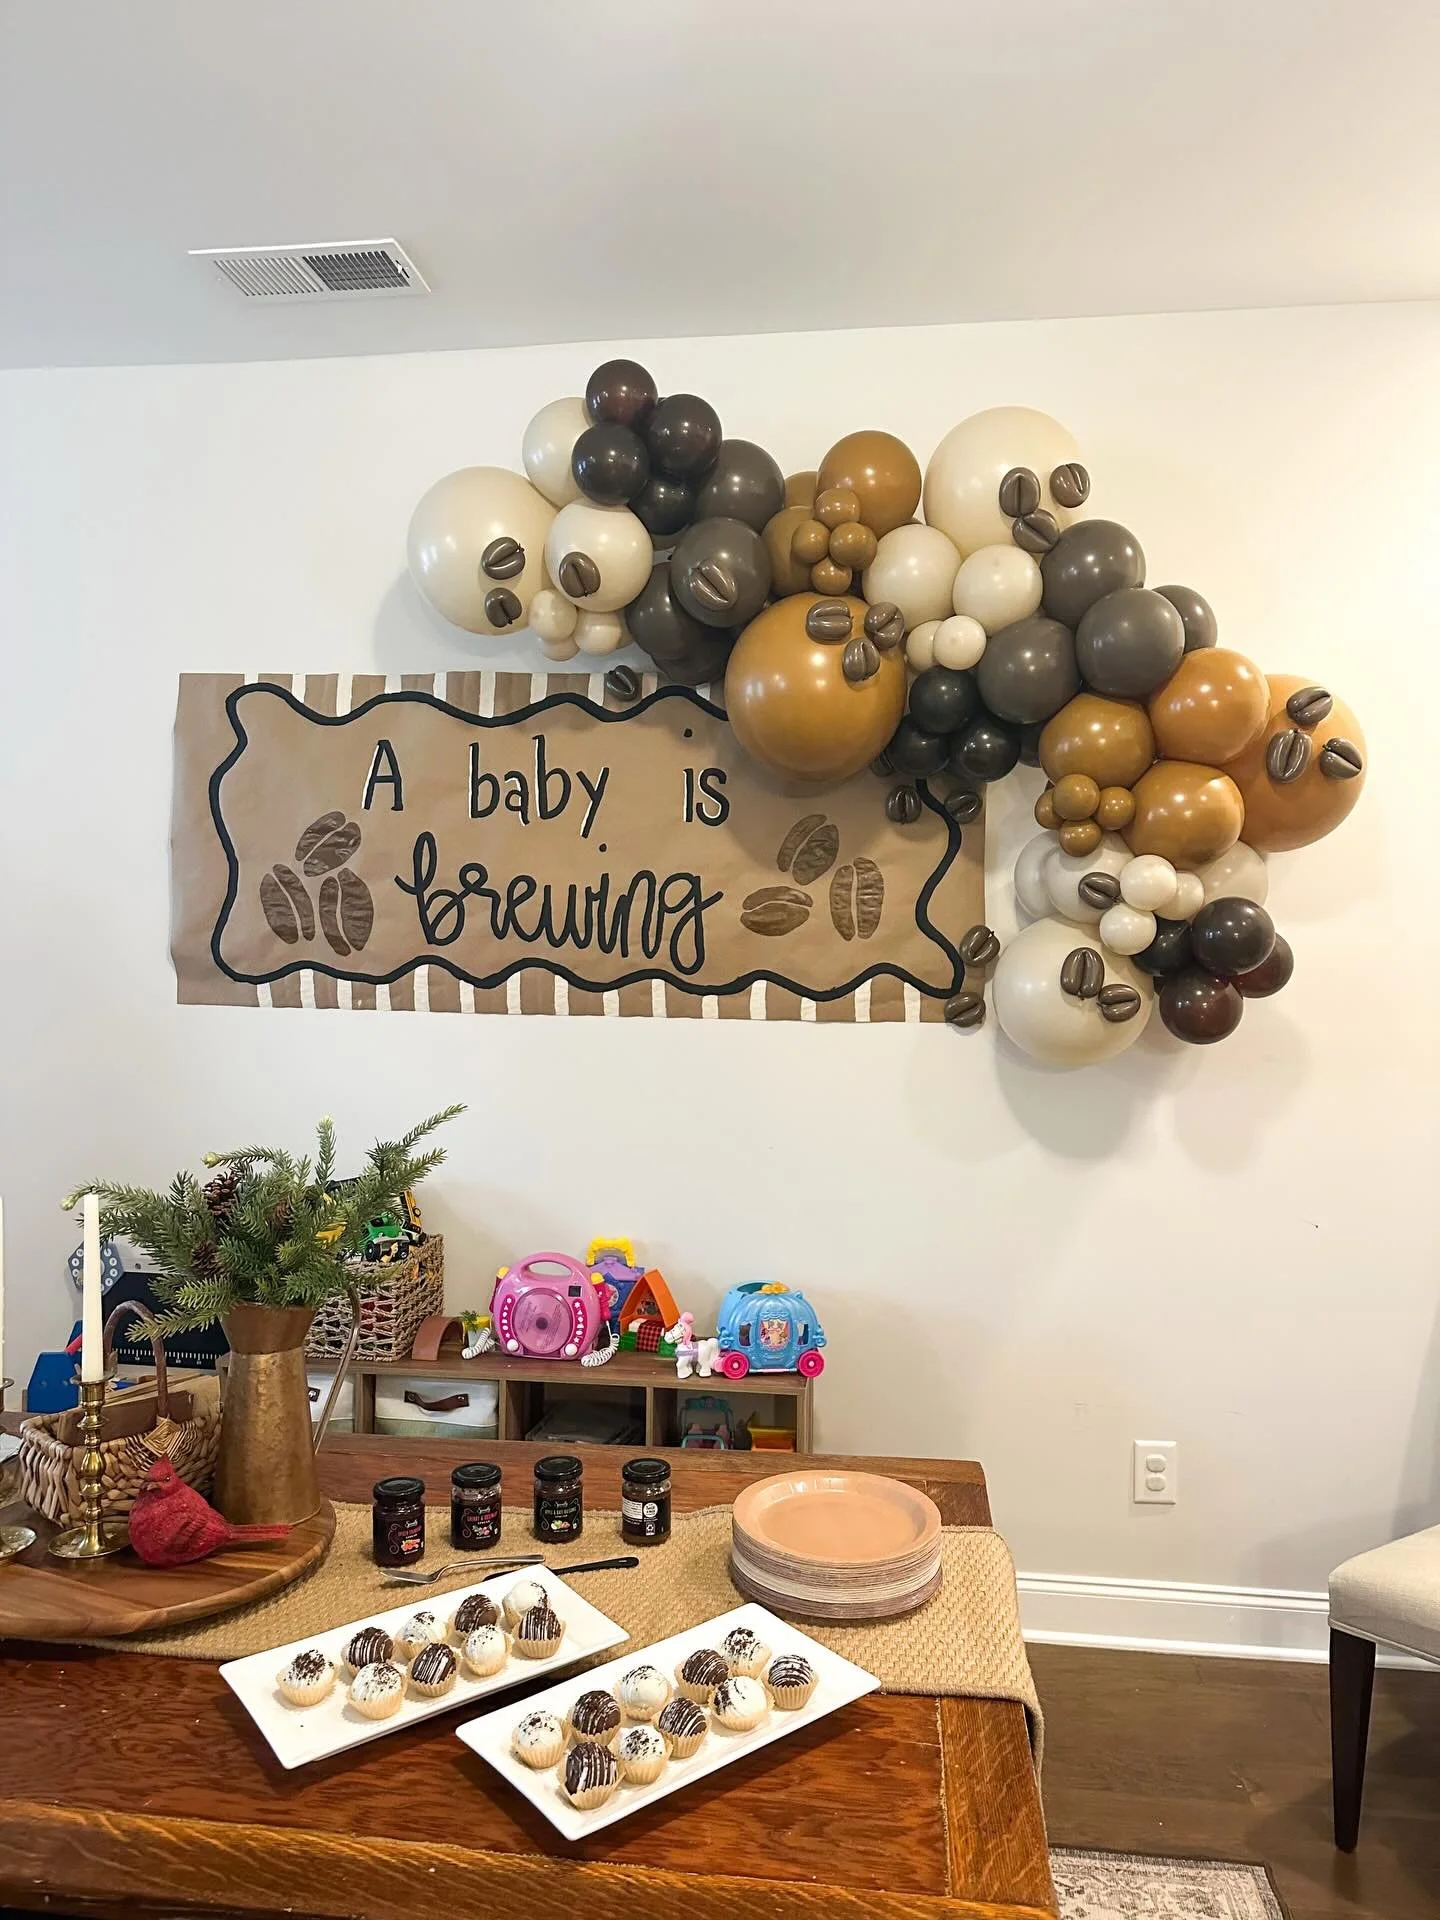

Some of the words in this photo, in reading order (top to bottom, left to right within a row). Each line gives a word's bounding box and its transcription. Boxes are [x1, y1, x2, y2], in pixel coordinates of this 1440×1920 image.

[361, 739, 404, 811] A
[468, 734, 610, 838] baby
[682, 728, 730, 827] is
[394, 831, 724, 975] brewing
